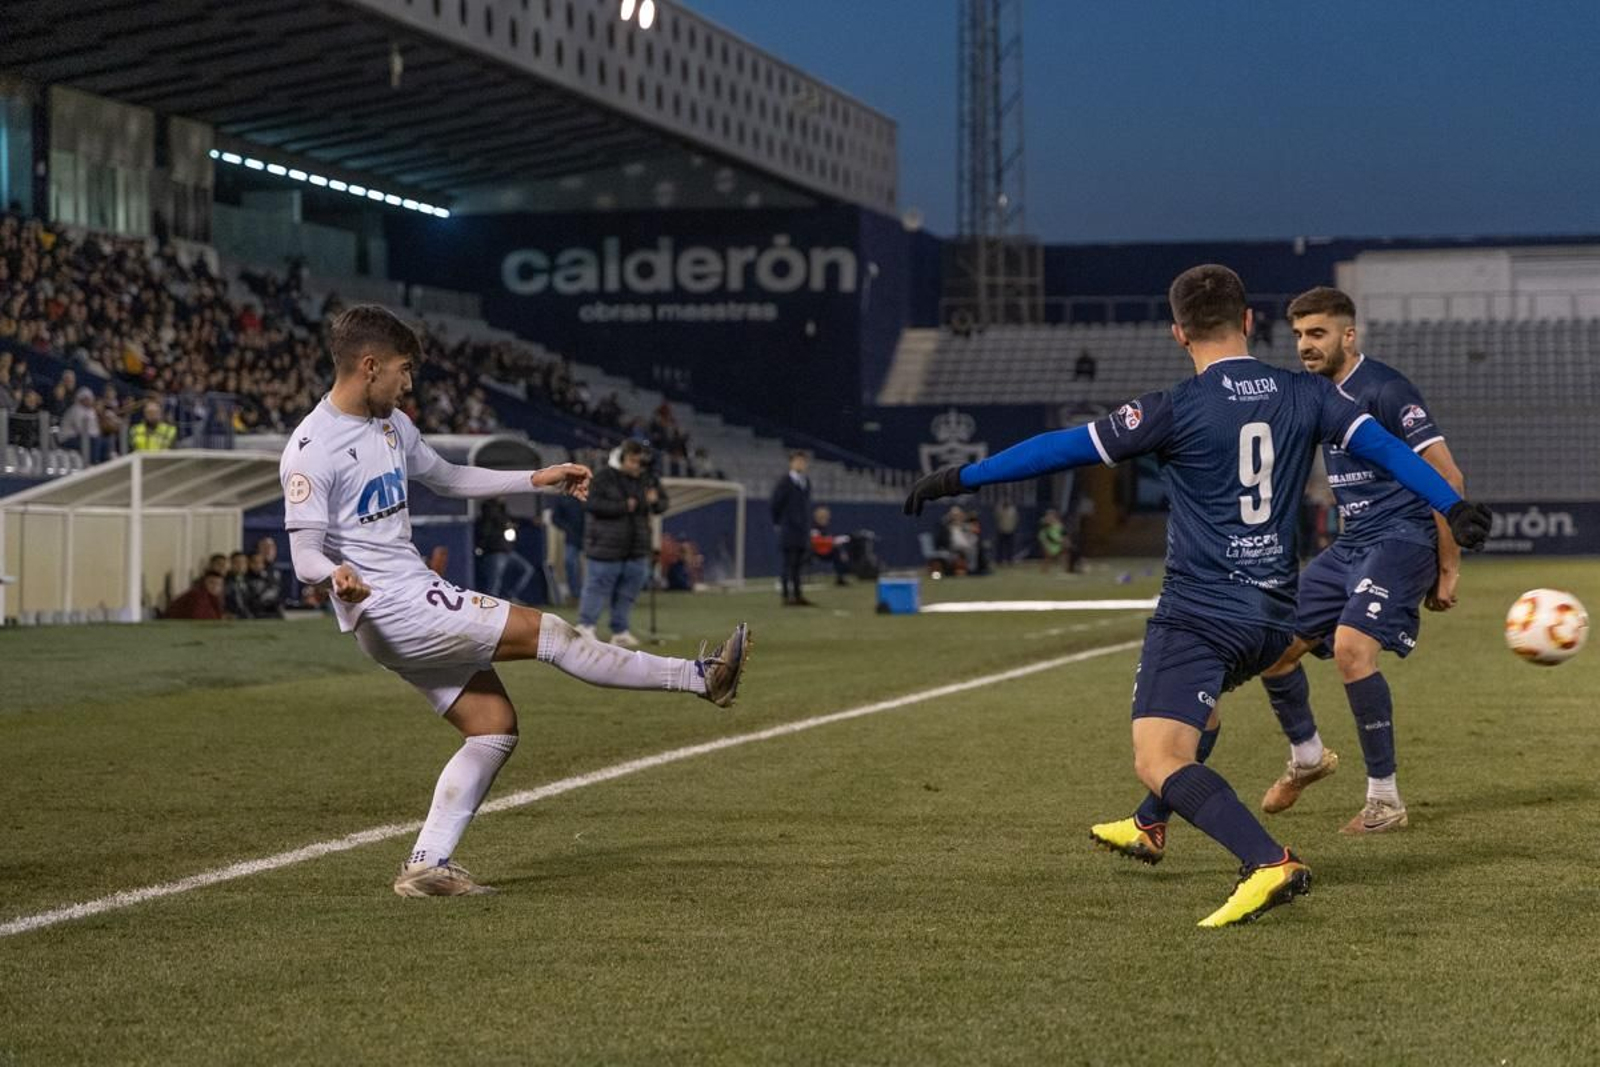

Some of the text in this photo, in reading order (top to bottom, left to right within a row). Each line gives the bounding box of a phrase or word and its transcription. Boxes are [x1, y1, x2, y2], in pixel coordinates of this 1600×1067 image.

[501, 233, 857, 294] calderón
[578, 301, 778, 323] obras maestras
[1234, 376, 1278, 396] MOLERA
[1238, 422, 1275, 525] 9
